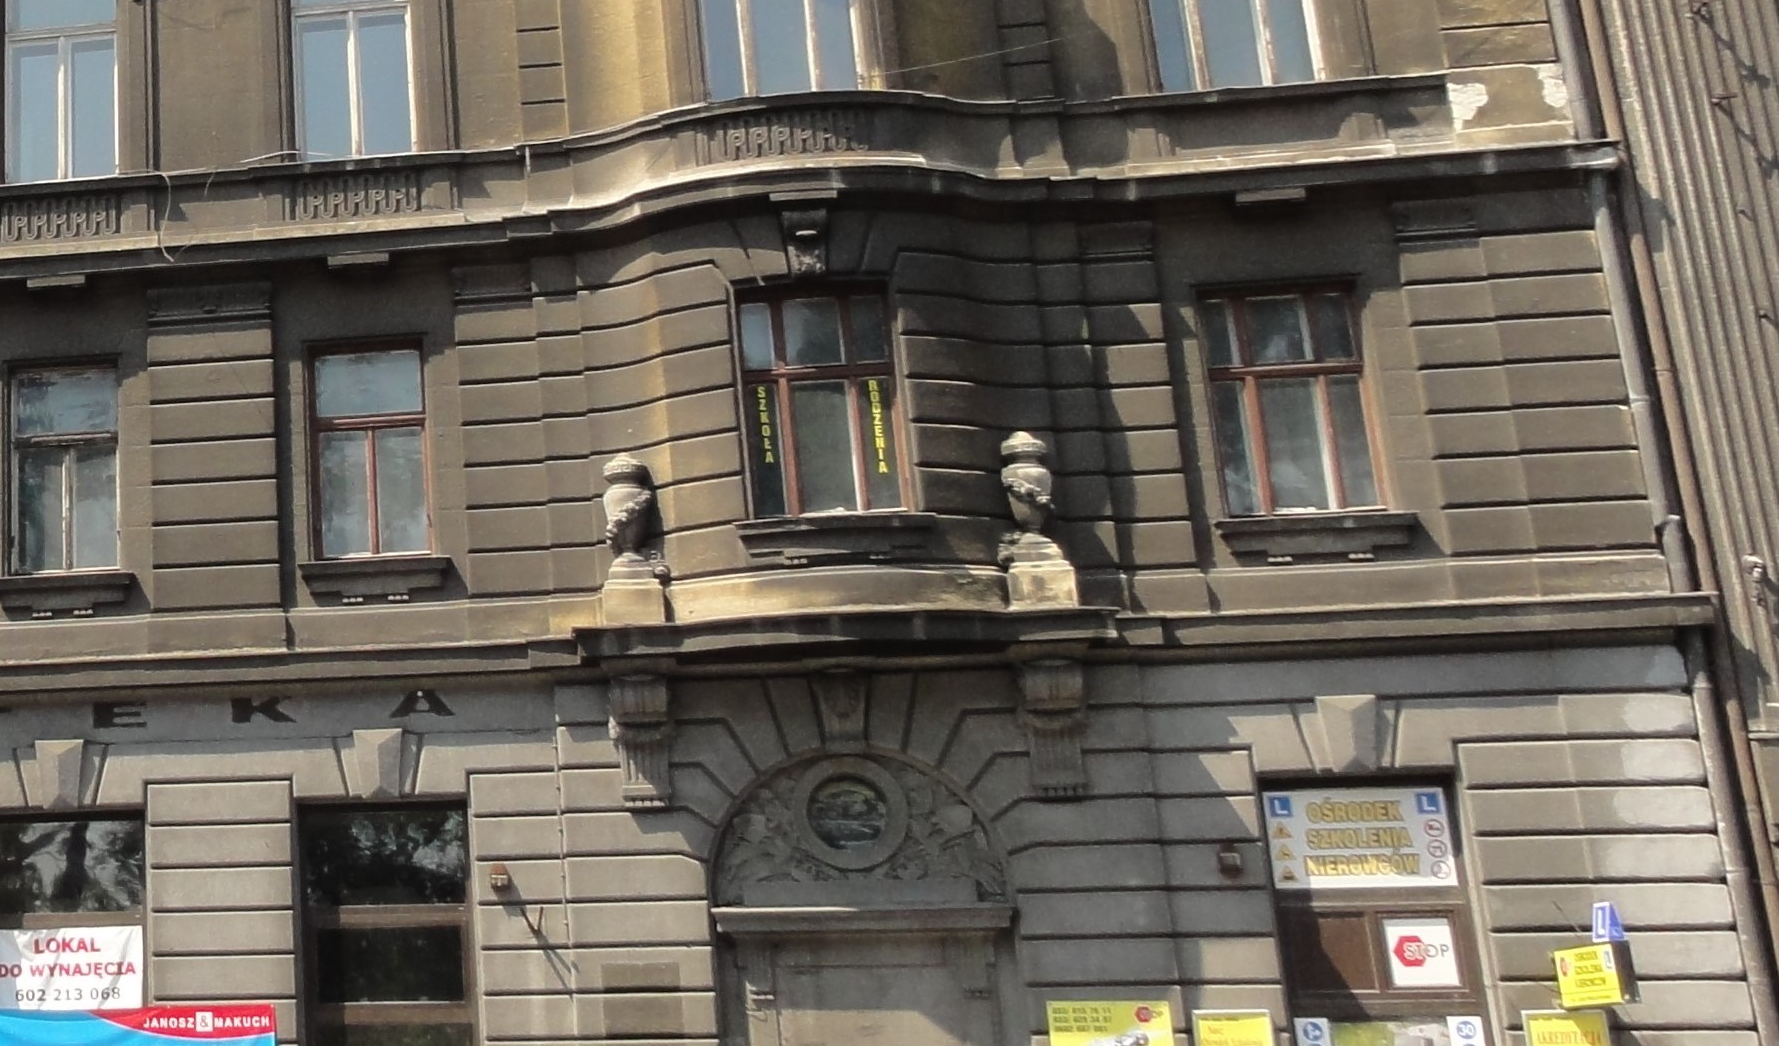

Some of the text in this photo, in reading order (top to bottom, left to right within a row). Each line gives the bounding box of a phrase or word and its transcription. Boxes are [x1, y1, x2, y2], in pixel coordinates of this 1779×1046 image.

[757, 385, 774, 464] SZKOŁA
[868, 379, 889, 475] RODZENIA
[1273, 798, 1290, 815] L
[1305, 797, 1405, 823] OŚRODEK
[1420, 795, 1438, 812] L
[1305, 827, 1415, 850] SZKOLENIA
[33, 937, 101, 954] LOKAL
[1403, 942, 1450, 961] STOP
[30, 961, 136, 979] WYNAJĘCIA
[15, 986, 121, 1002] 602 213 068
[143, 1017, 195, 1029] JANOSZ
[214, 1016, 270, 1028] MAKUCH
[1458, 1023, 1476, 1039] 30
